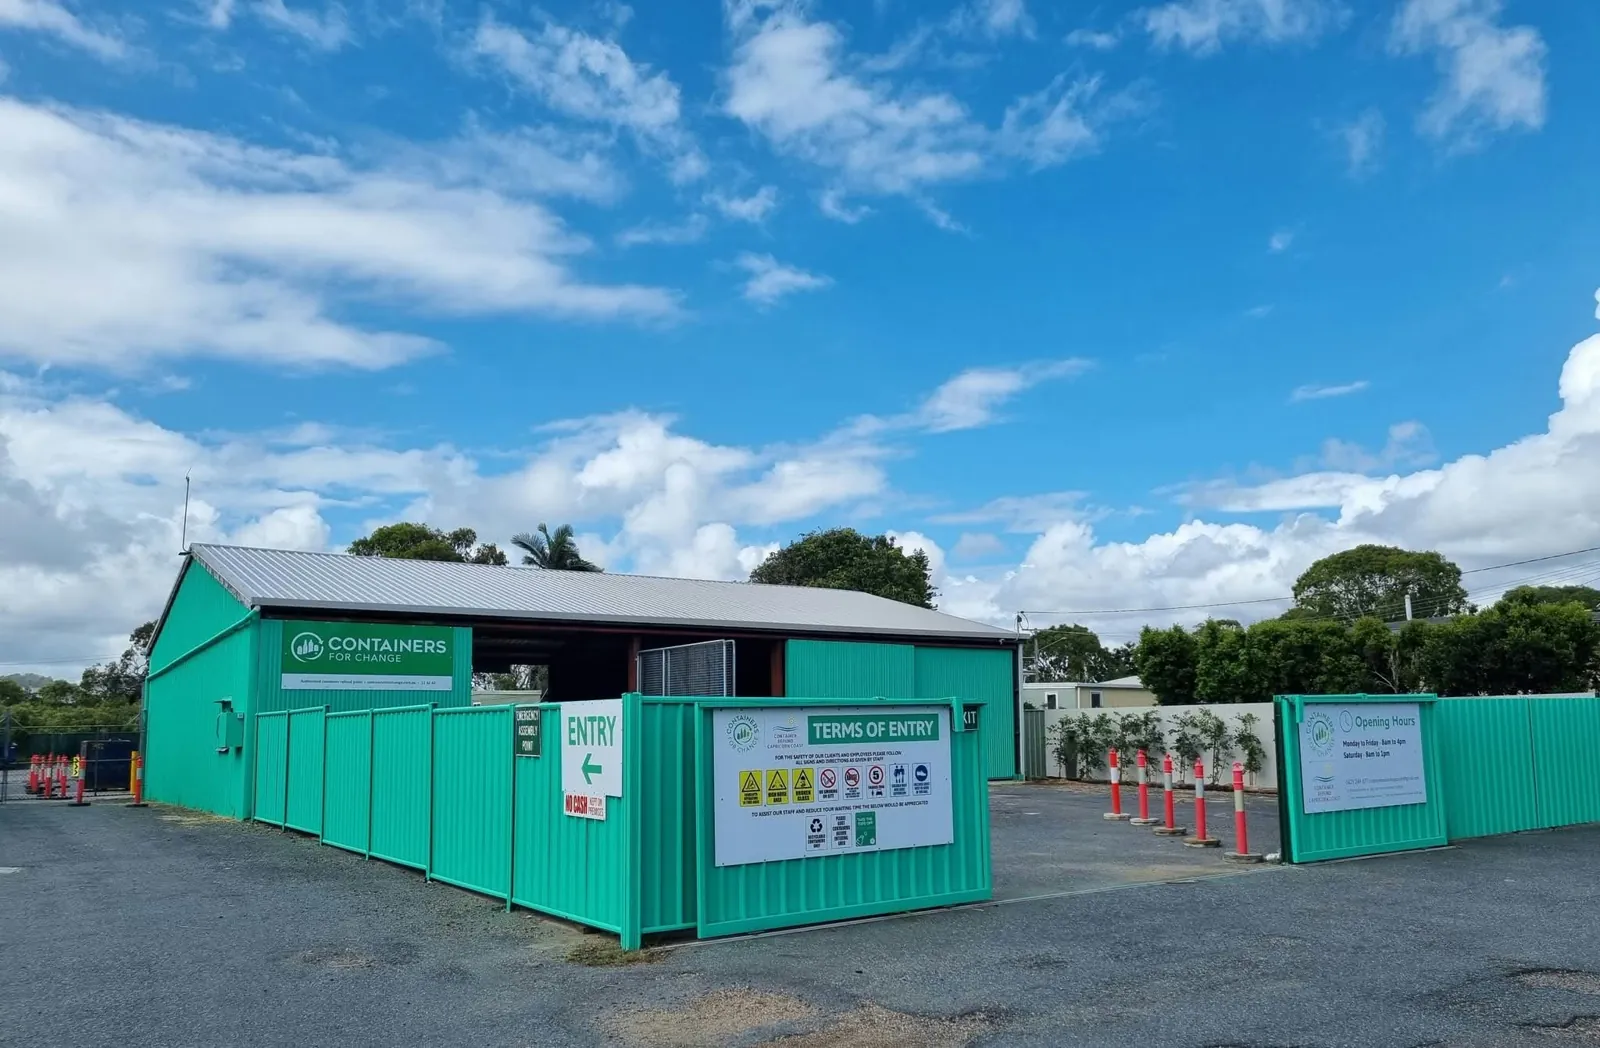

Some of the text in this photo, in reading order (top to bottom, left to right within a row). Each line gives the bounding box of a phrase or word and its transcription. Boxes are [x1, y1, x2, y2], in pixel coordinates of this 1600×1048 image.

[328, 636, 447, 654] CONTAINERS
[328, 652, 402, 663] FOR CHANGE
[516, 710, 539, 721] EMERGENCY
[726, 714, 760, 735] CONTAINERS
[1355, 715, 1416, 730] Opening Hours
[518, 725, 538, 736] ASSEMBLY
[568, 715, 617, 747] ENTRY
[812, 720, 934, 739] TERMS OF ENTRY
[522, 740, 533, 751] POINT
[1342, 740, 1360, 749] Monday
[1365, 739, 1379, 748] Friday
[1396, 738, 1406, 747] 4pm
[1343, 751, 1362, 760] Saturday
[1380, 750, 1390, 758] 1pm
[872, 770, 880, 780] 5
[565, 794, 588, 814] NO CASH
